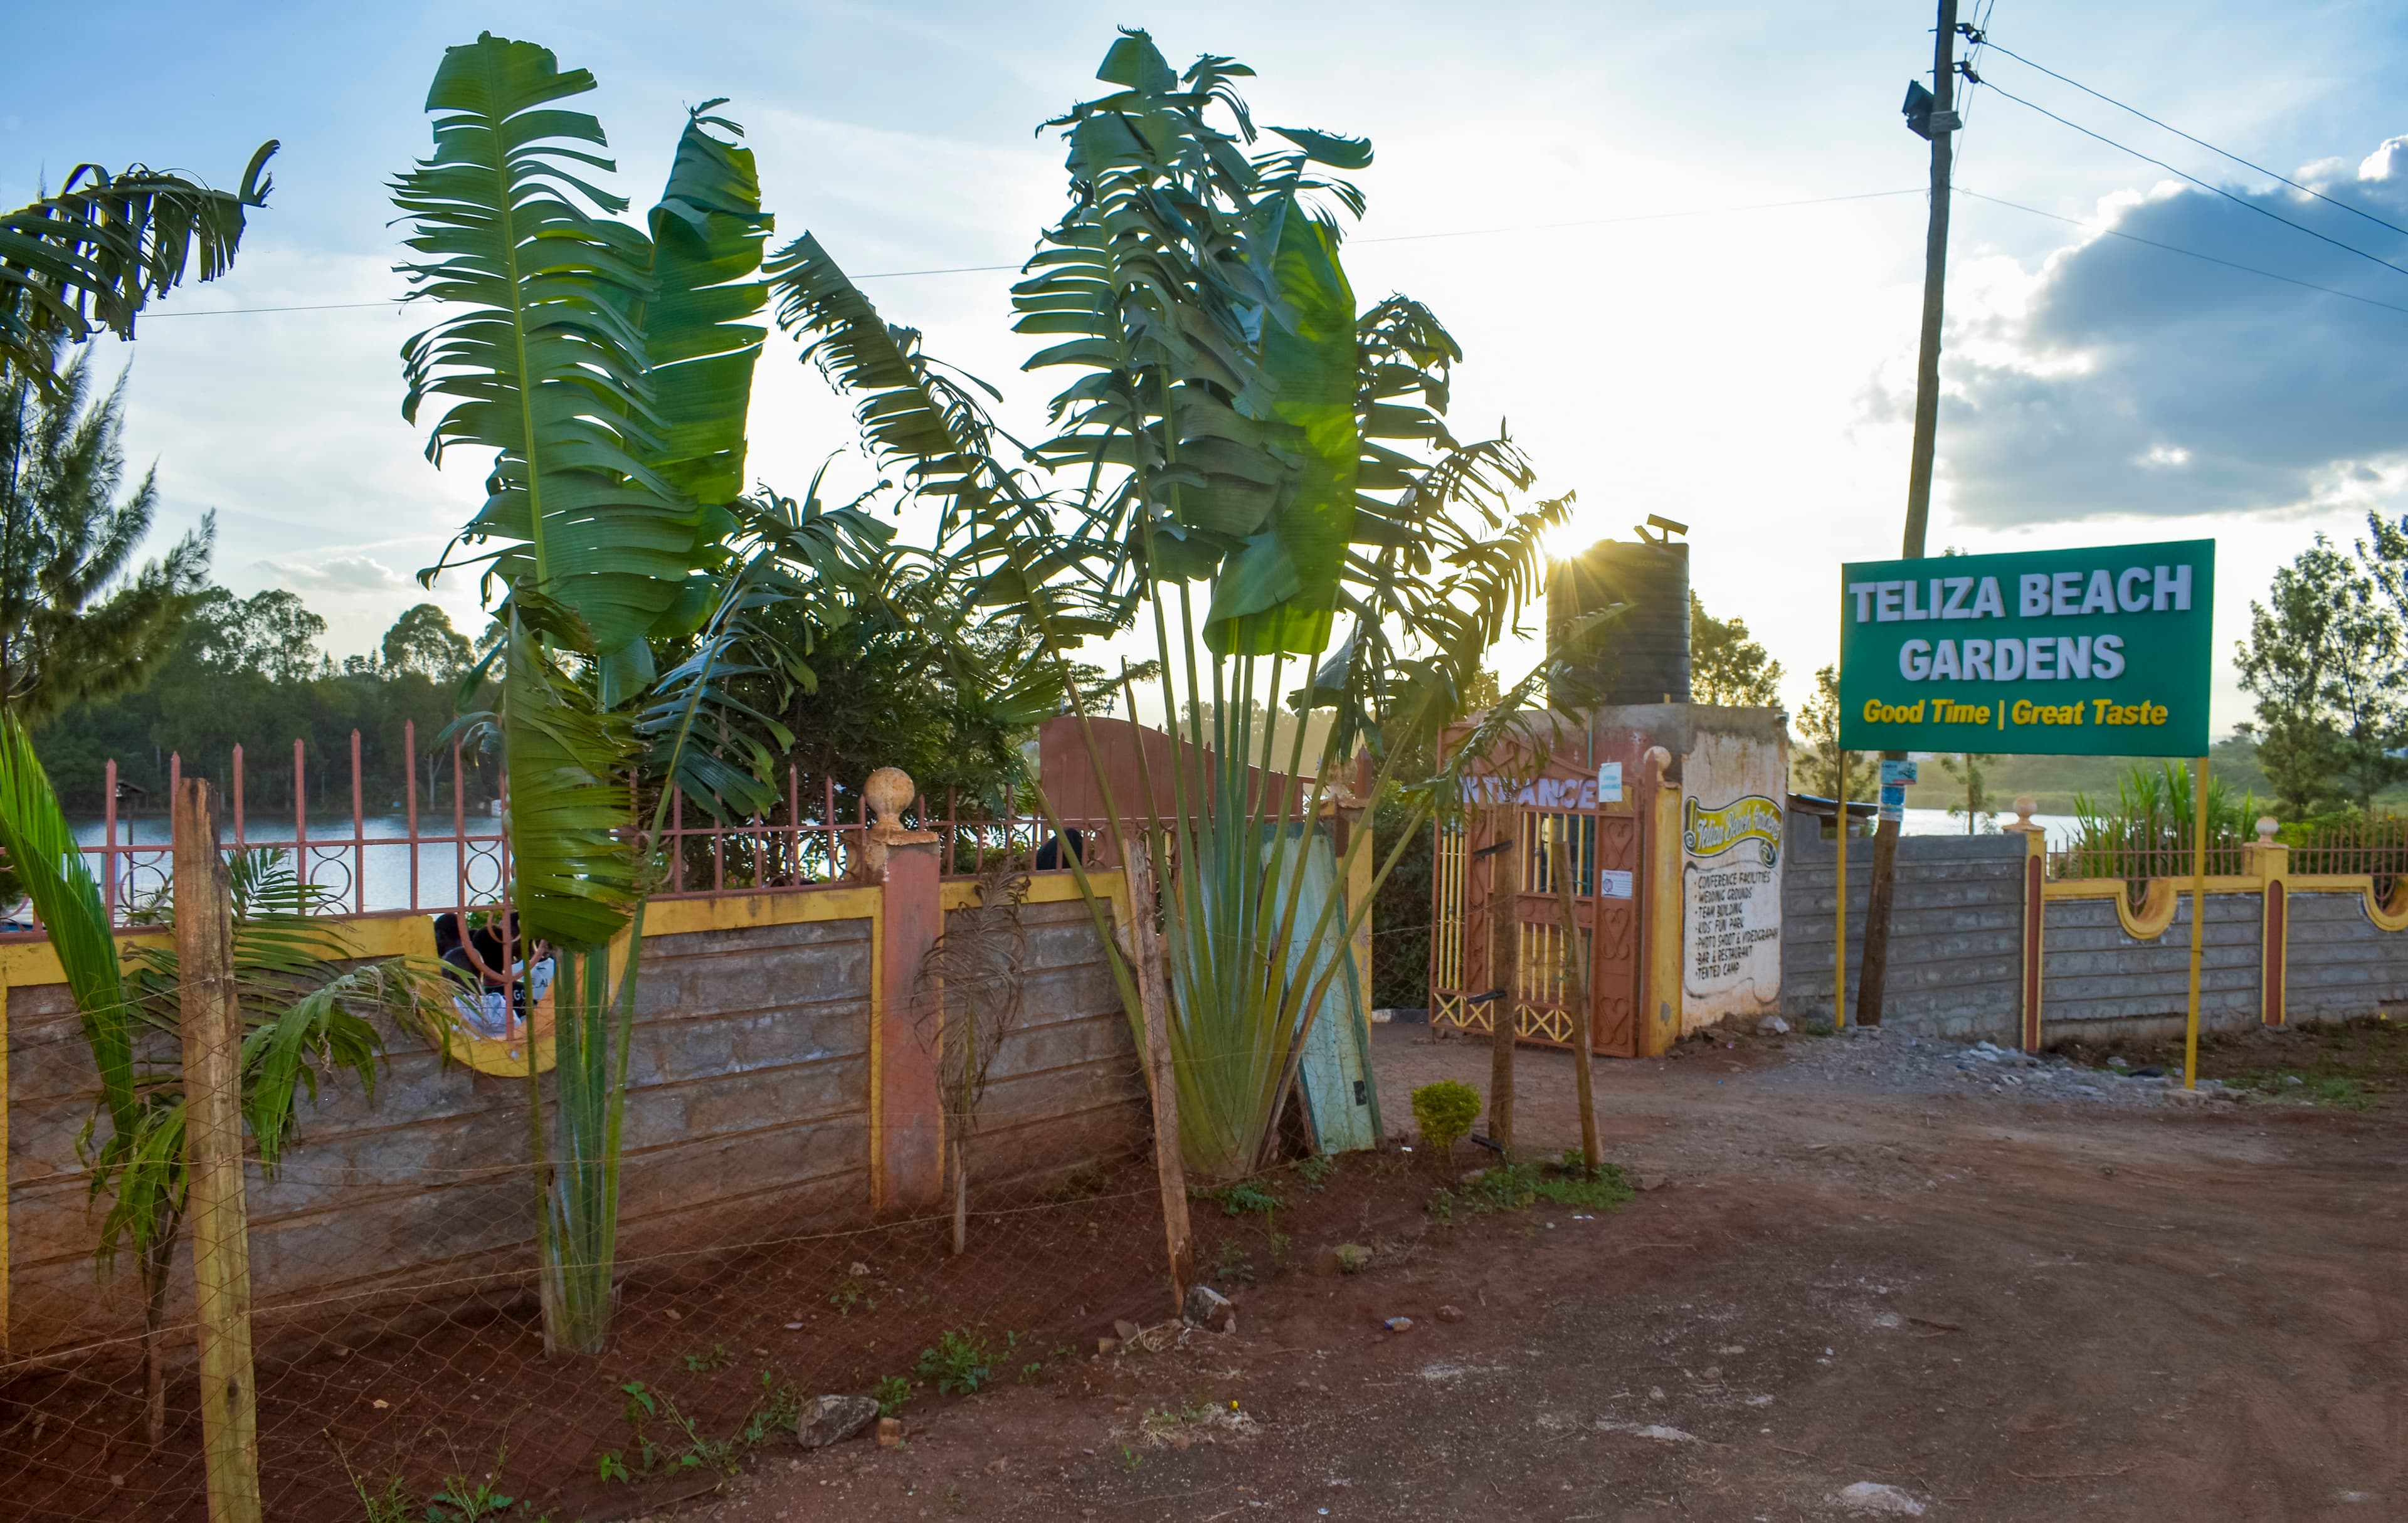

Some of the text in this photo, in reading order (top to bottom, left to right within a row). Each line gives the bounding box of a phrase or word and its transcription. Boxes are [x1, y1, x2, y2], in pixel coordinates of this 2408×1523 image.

[1849, 565, 2192, 623] TELIZA BEACH
[1899, 635, 2125, 682] GARDENS
[1863, 699, 1926, 724] Good
[1931, 698, 1991, 725] Time
[2011, 699, 2085, 725] Great
[2092, 698, 2168, 726] Taste
[1698, 870, 1772, 889] CONFERENCE FACILITIES
[1698, 887, 1753, 904] WEDDING GROUNDS
[1698, 902, 1743, 919] TEAM BUILDING
[1715, 919, 1727, 932] FUN
[1729, 917, 1745, 929] PARK
[1698, 935, 1716, 949] PHOTO
[1698, 952, 1710, 965] BAR
[1718, 945, 1753, 961] RESTAURANT
[1698, 961, 1740, 980] TENTED CAMP
